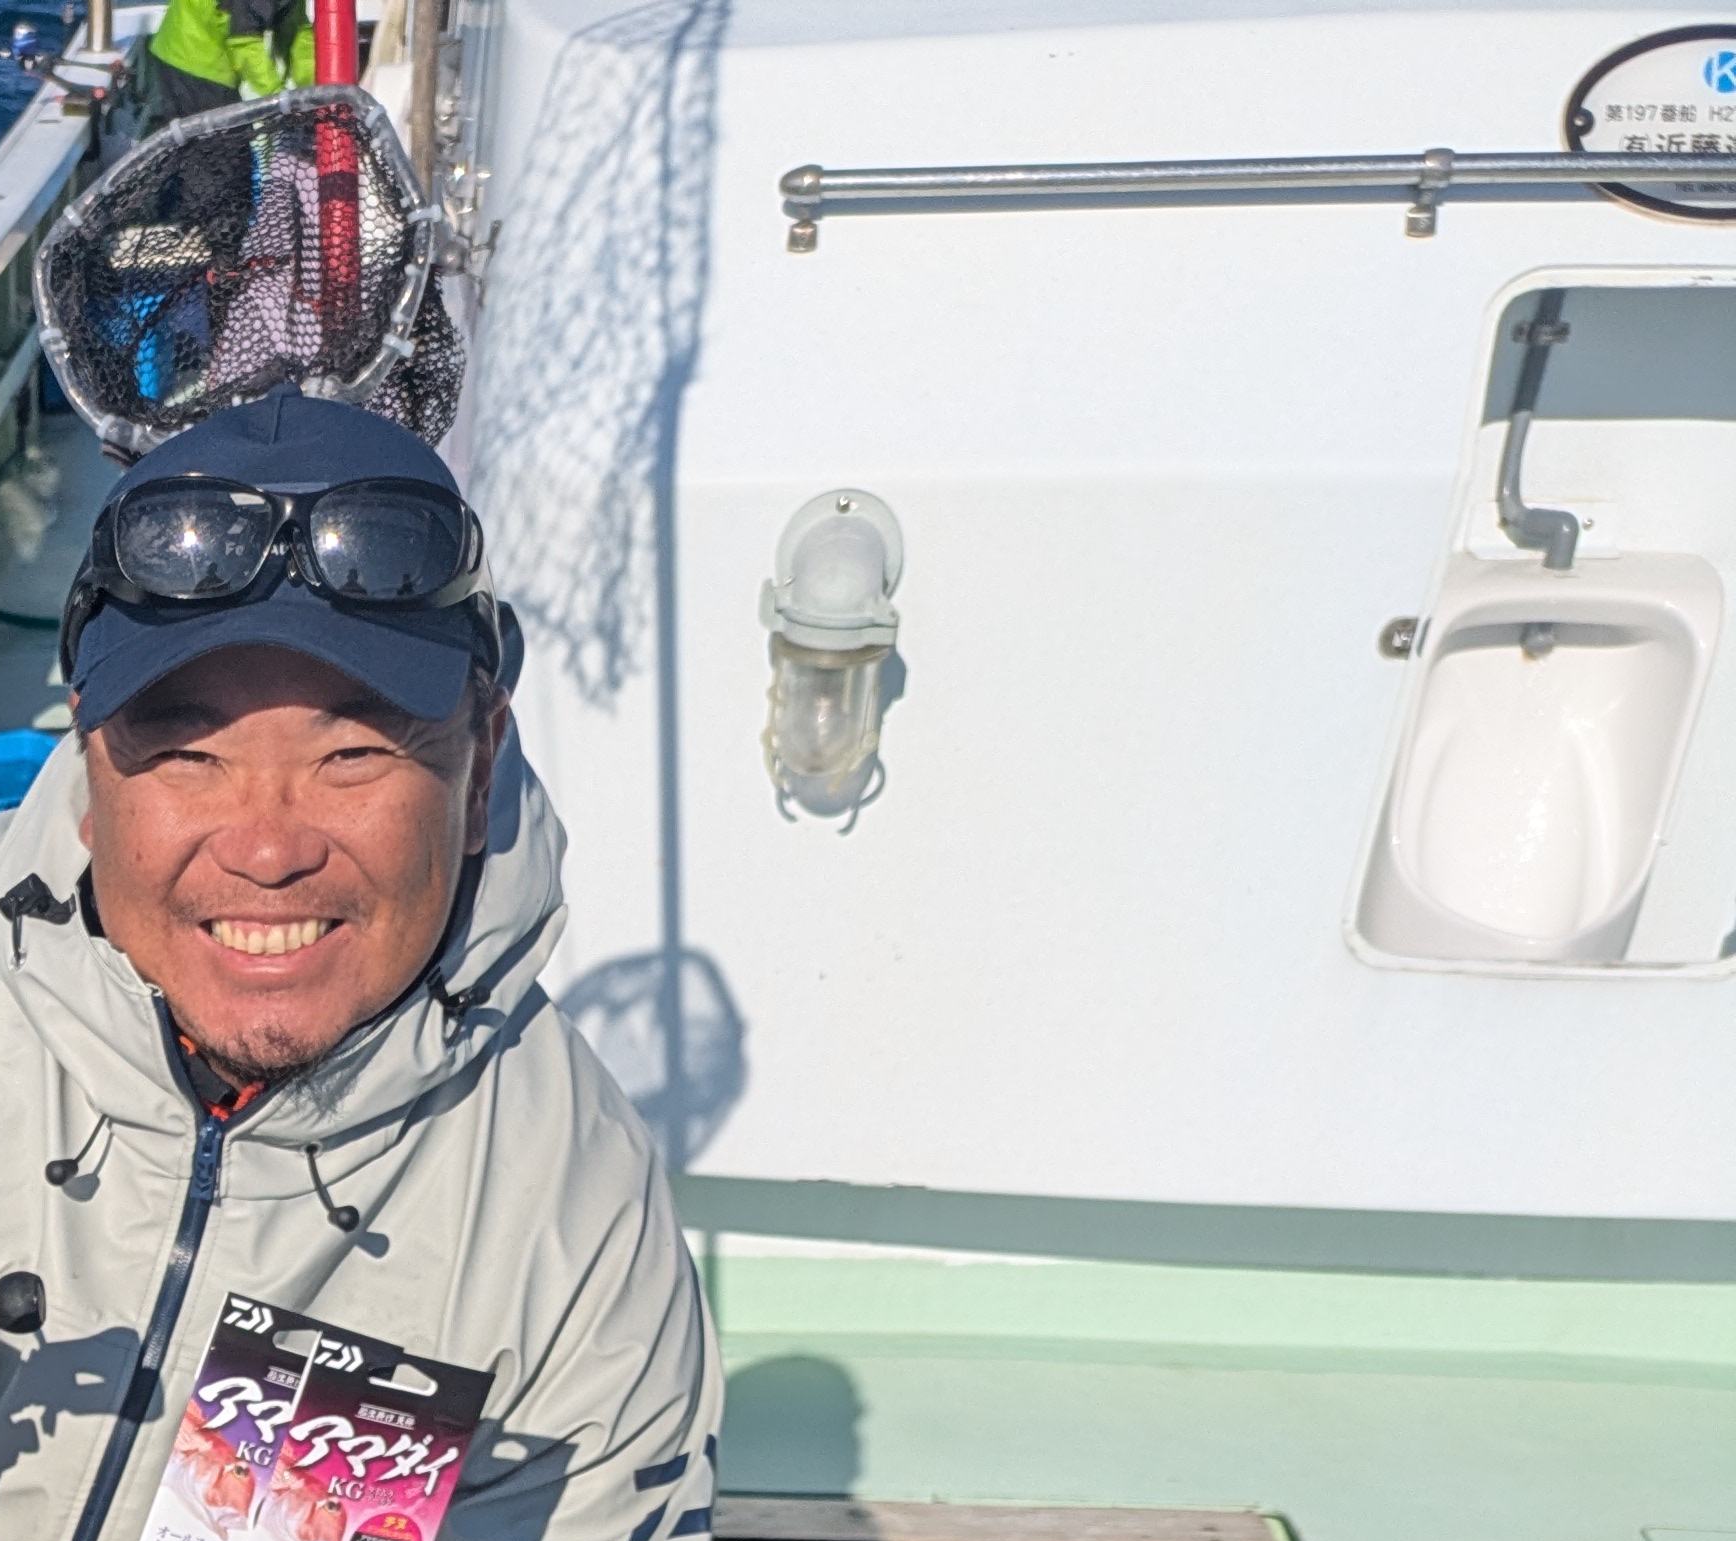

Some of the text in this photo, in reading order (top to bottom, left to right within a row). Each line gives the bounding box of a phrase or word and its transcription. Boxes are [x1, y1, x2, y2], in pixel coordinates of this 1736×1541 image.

[1709, 105, 1736, 122] H2
[236, 1440, 274, 1467] KG
[288, 1414, 459, 1496] アマダイ
[327, 1475, 365, 1502] KG
